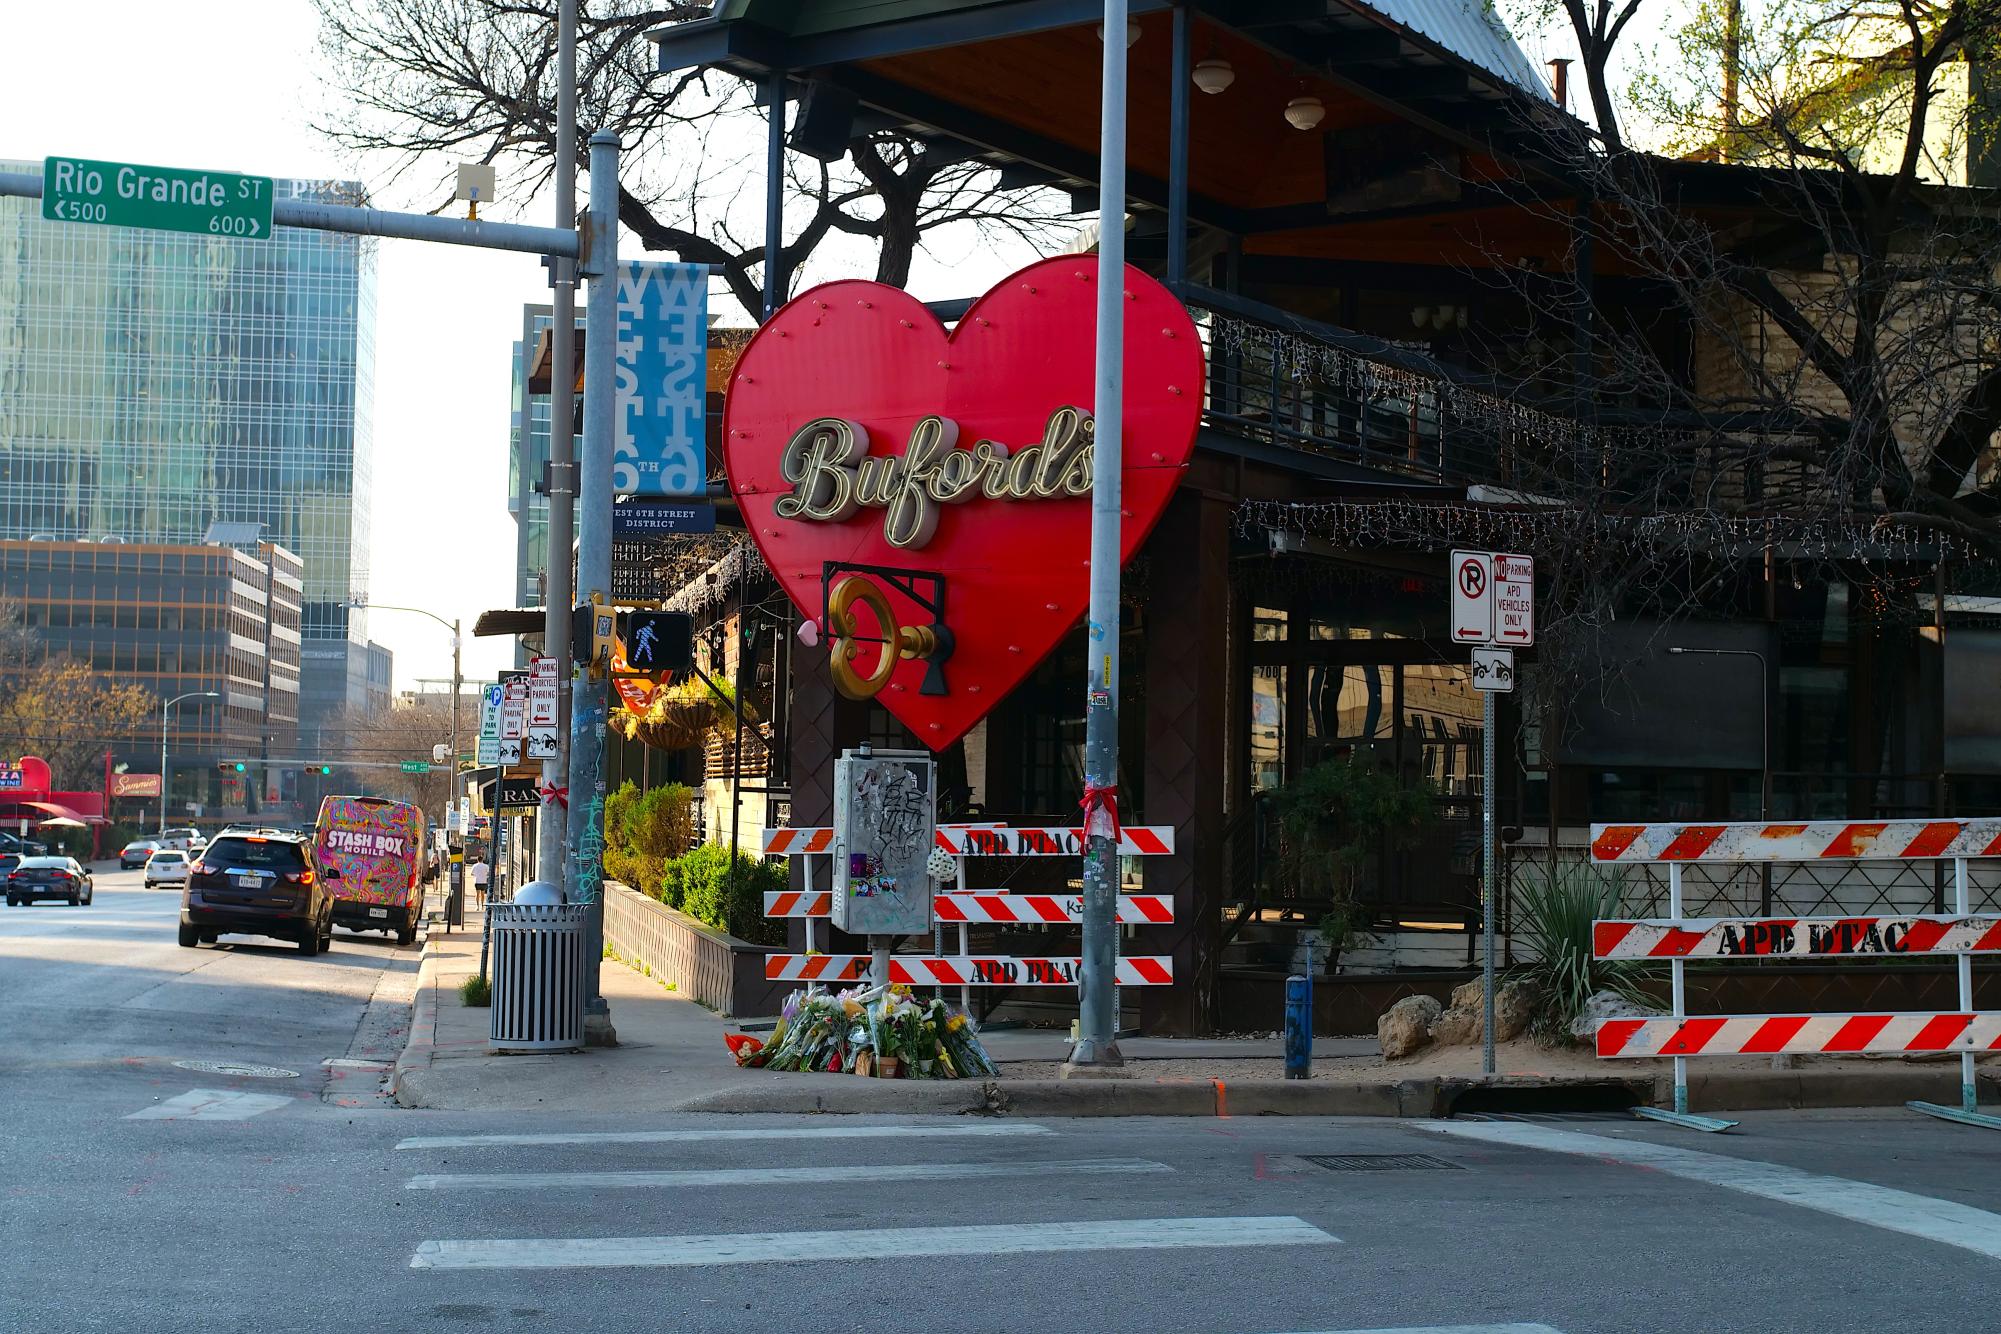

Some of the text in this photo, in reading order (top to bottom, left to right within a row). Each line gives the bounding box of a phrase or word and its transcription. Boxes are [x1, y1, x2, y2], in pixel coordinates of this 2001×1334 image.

[55, 161, 262, 207] Rio Grande ST
[69, 202, 107, 222] 500
[208, 215, 246, 235] 600
[635, 509, 655, 518] 6TH
[657, 509, 696, 518] STREET
[625, 519, 675, 528] DISTRICT
[1495, 560, 1531, 577] NO PARKING
[1506, 585, 1521, 597] APD
[1497, 599, 1530, 612] VEHICLES
[1504, 614, 1523, 626] ONLY
[530, 662, 556, 675] NO PARKING
[1259, 666, 1278, 678] 700
[532, 678, 556, 687] MOTORCYCLE
[532, 690, 556, 699] PARKING
[536, 703, 551, 713] ONLY
[402, 763, 417, 771] West
[114, 775, 157, 795] Sammie's
[327, 829, 404, 856] STASH BOX
[959, 832, 1009, 856] APD
[344, 846, 385, 857] MOBILE
[1717, 921, 1911, 955] APD DTAC
[969, 961, 1018, 984] APD
